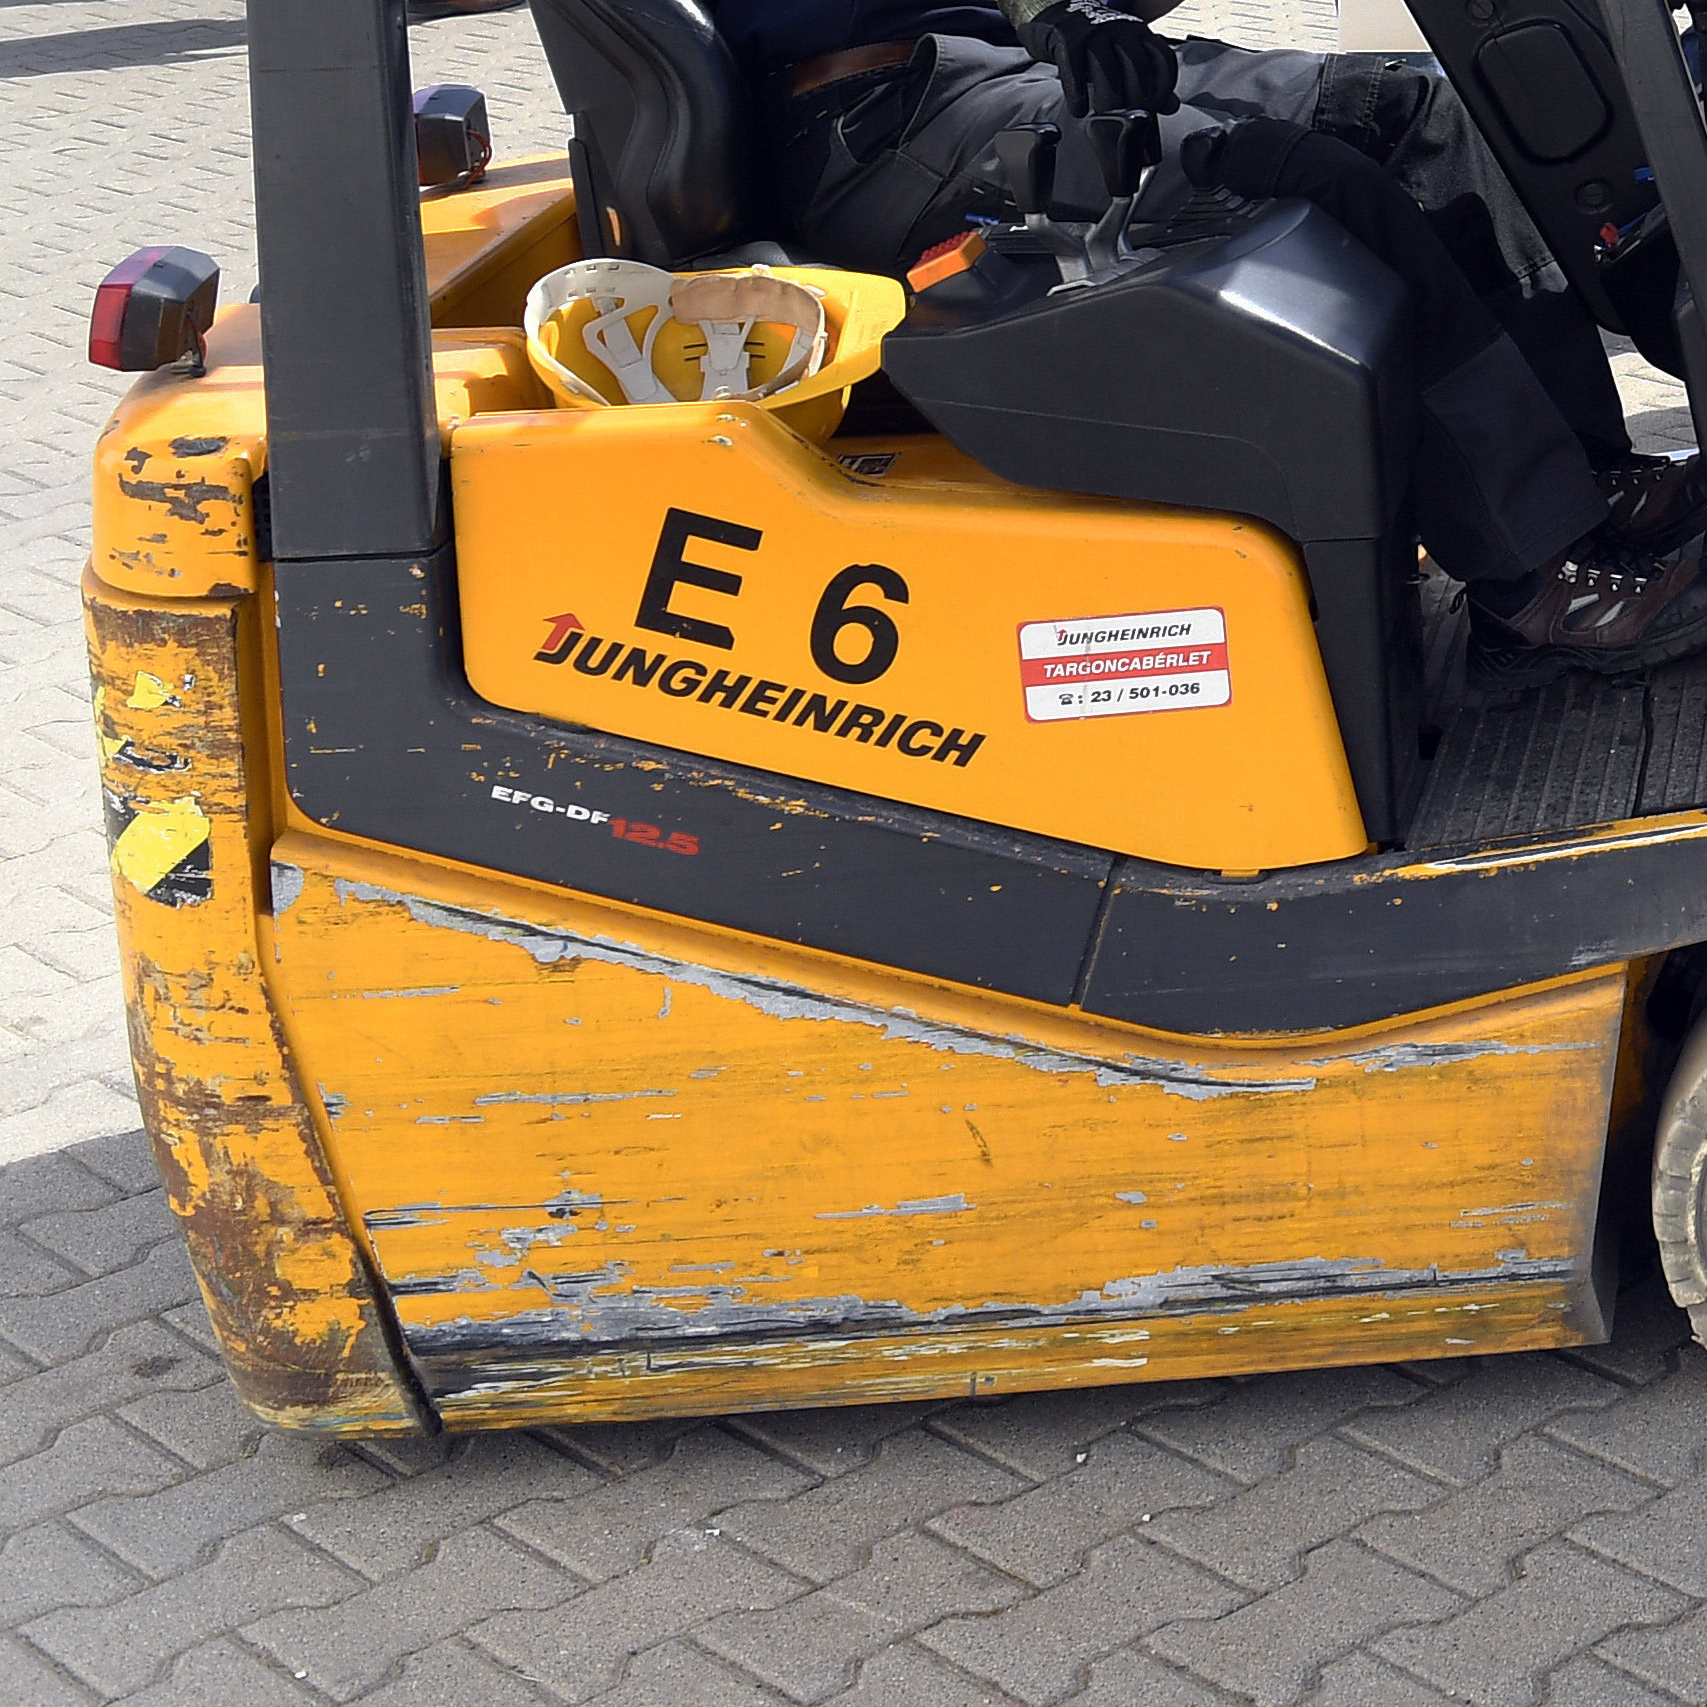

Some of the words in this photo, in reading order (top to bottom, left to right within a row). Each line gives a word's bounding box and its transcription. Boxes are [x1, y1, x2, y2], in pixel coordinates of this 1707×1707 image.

[634, 507, 764, 651] E
[809, 562, 910, 686] 6
[1057, 623, 1193, 647] JUNGHEINRICH
[1044, 650, 1213, 679] TARGONCABÉRLET
[533, 630, 987, 768] JUNGHEINRICH
[1090, 690, 1113, 704] 23
[1117, 688, 1125, 703] /
[1129, 682, 1201, 701] 501-036
